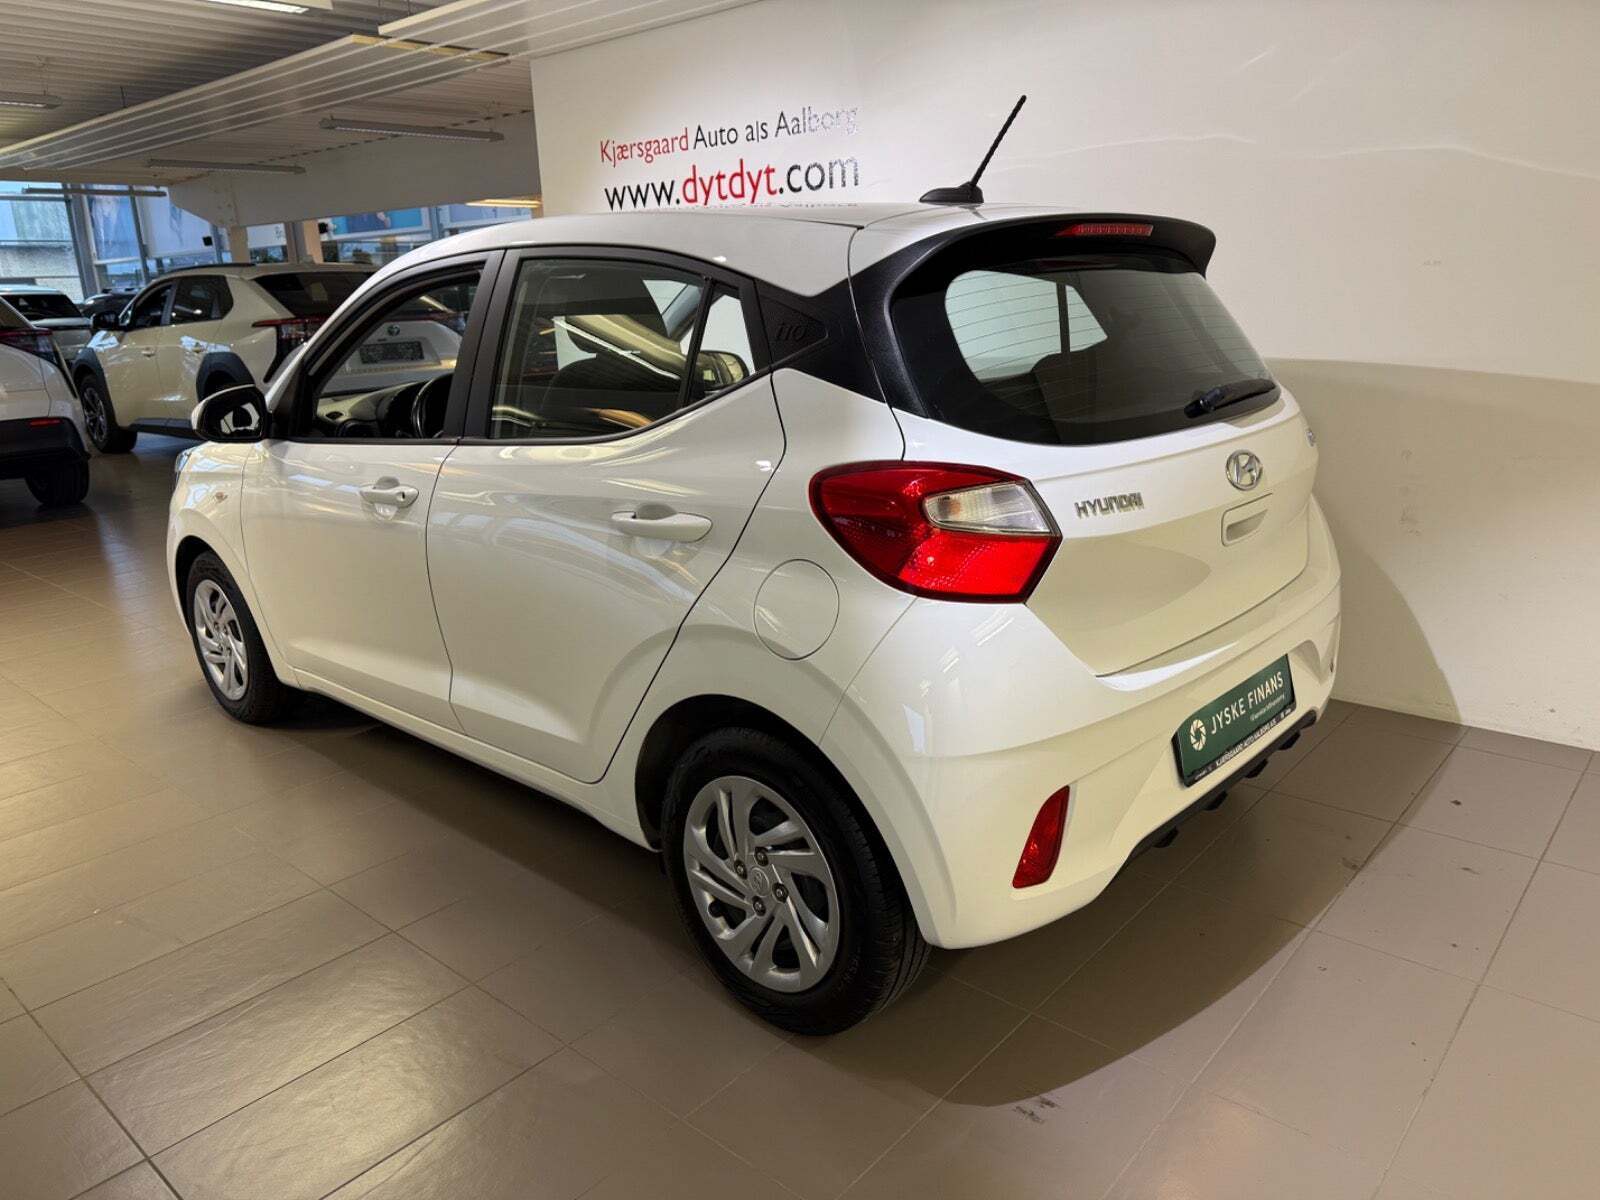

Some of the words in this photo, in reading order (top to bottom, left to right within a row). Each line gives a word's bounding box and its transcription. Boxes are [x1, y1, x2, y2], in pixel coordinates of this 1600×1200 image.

[600, 127, 689, 168] Kjærsgaard
[693, 124, 738, 150] Auto
[604, 157, 859, 211] www.dytdyt.com
[1074, 491, 1144, 519] HYUNDAI
[1211, 698, 1246, 735] JYSKE
[1247, 671, 1284, 709] FINANS
